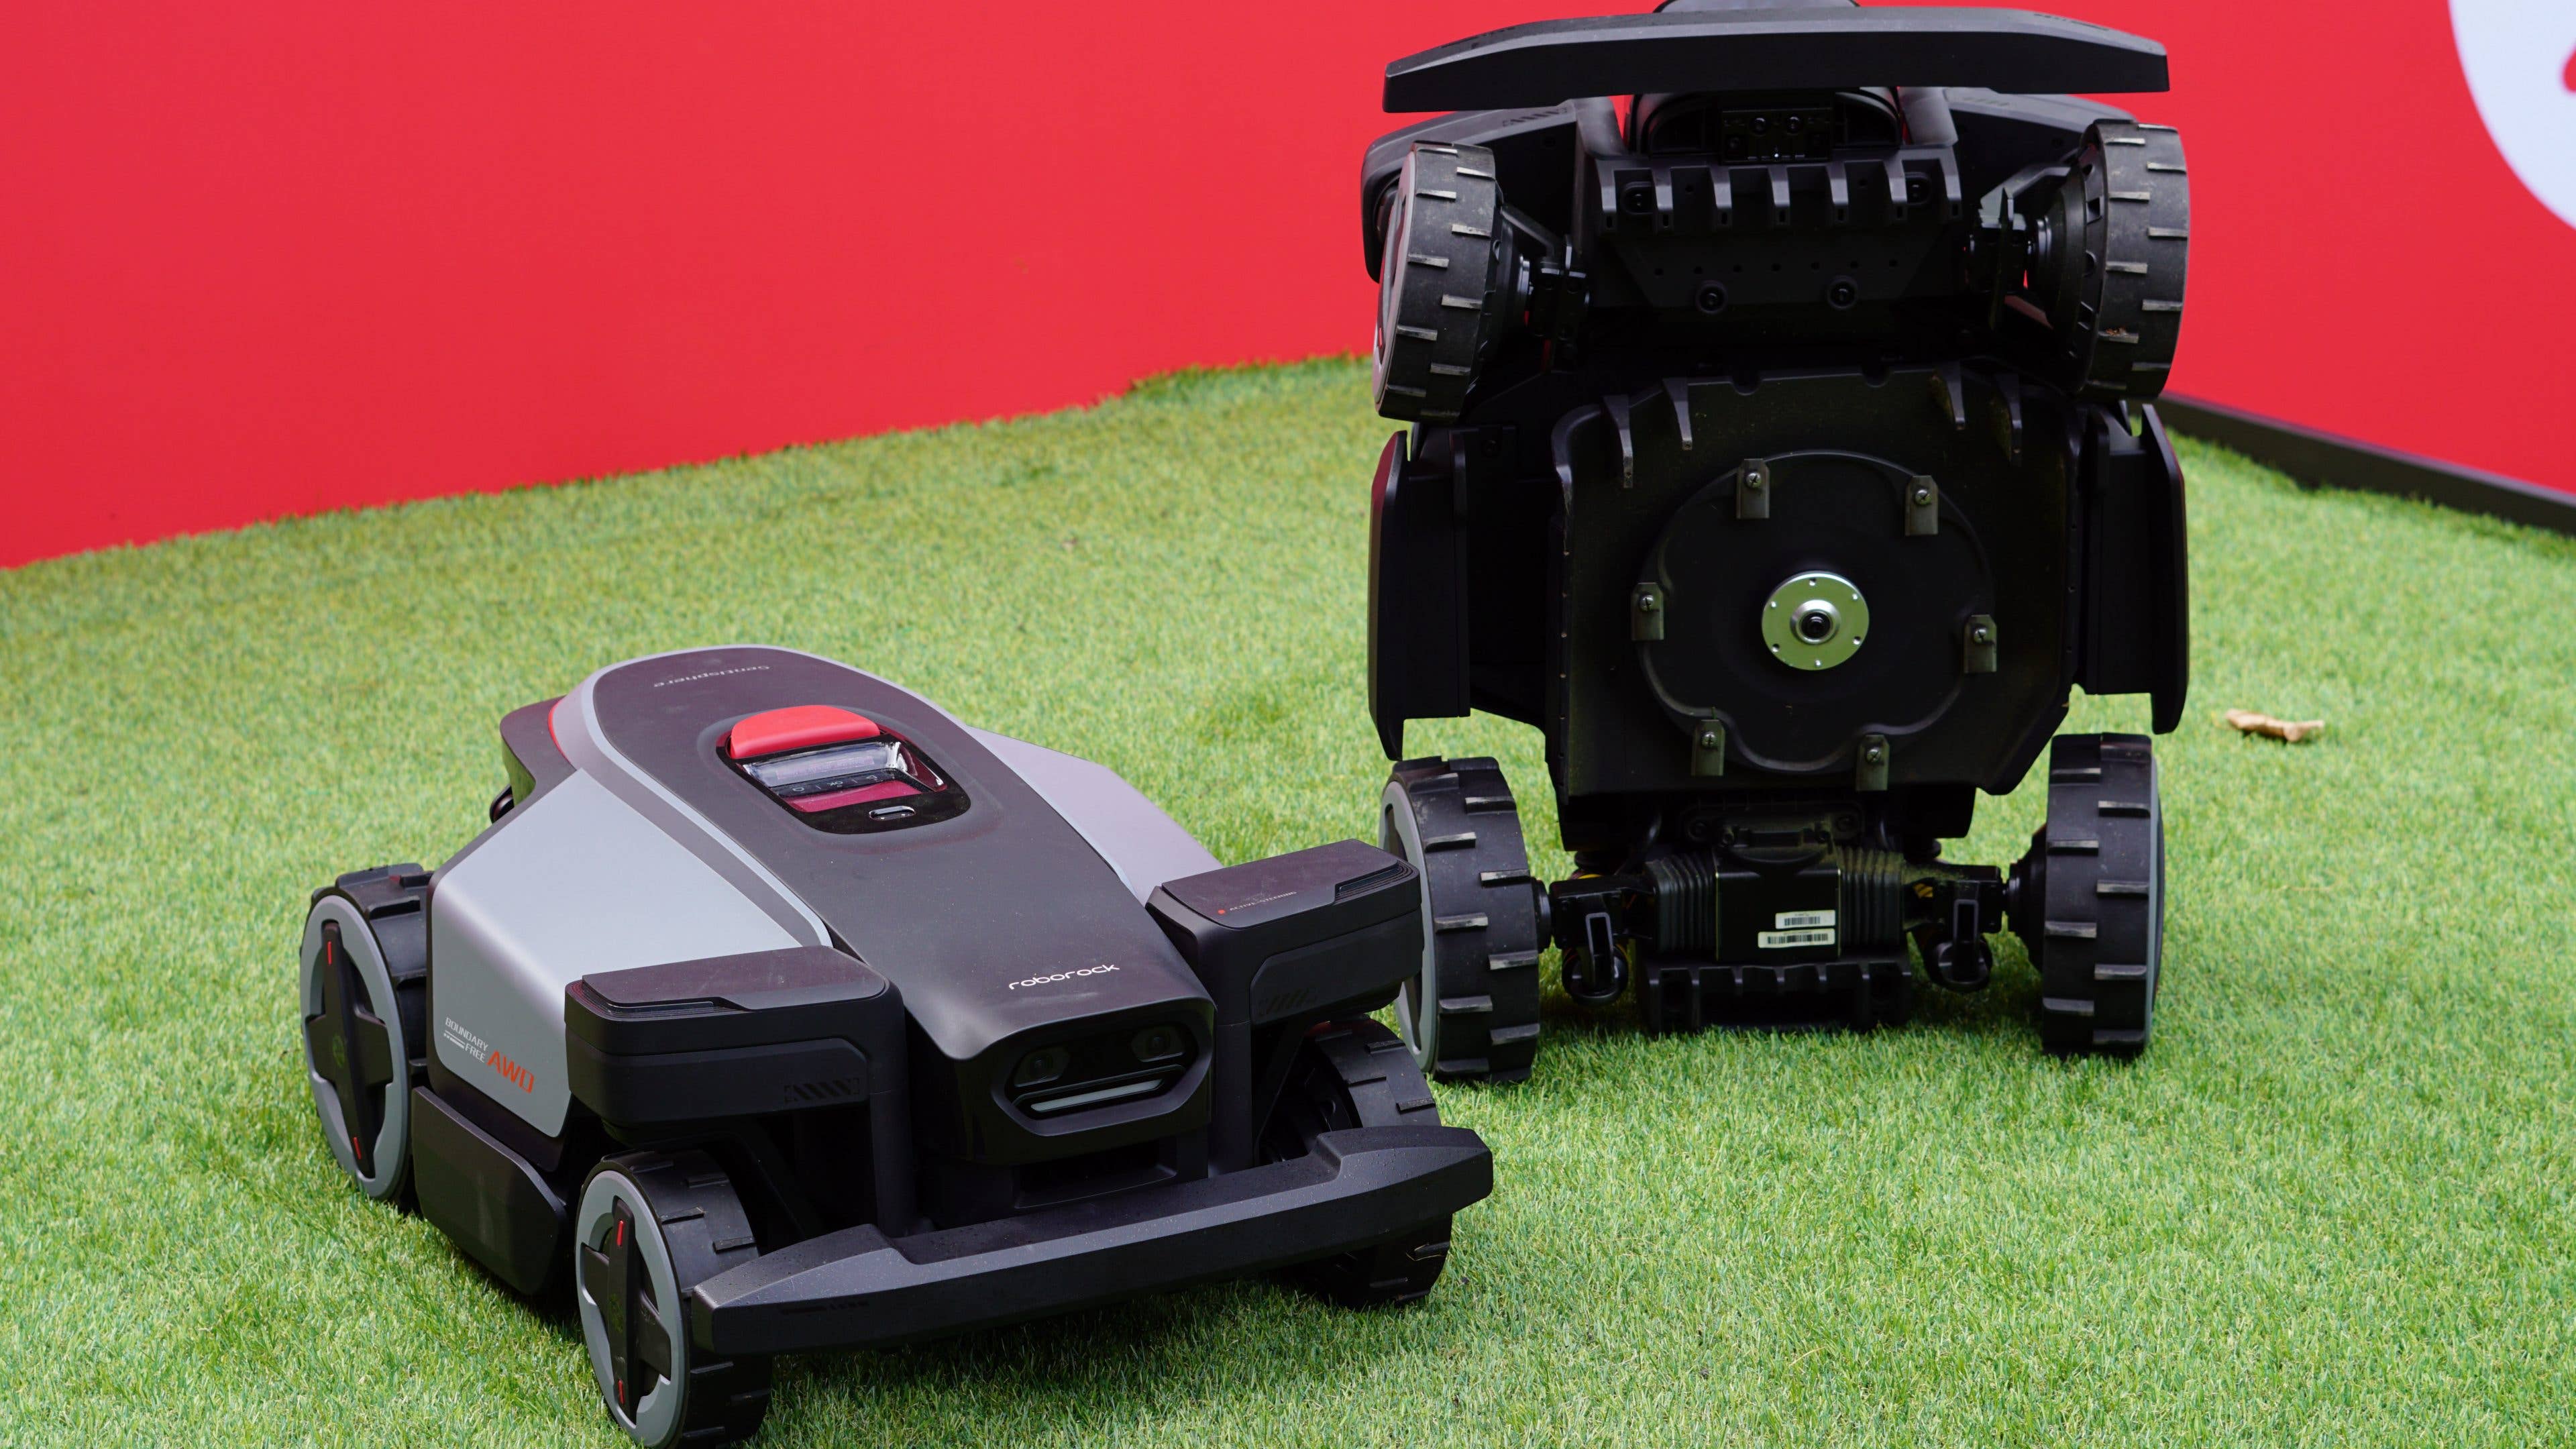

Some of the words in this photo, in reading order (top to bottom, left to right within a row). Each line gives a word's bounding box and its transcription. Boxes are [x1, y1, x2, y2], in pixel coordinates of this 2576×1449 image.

[1008, 964, 1120, 989] roborock
[445, 1017, 488, 1051] BOUNDARY
[465, 1042, 486, 1063] FREE
[488, 1051, 534, 1093] AWD
